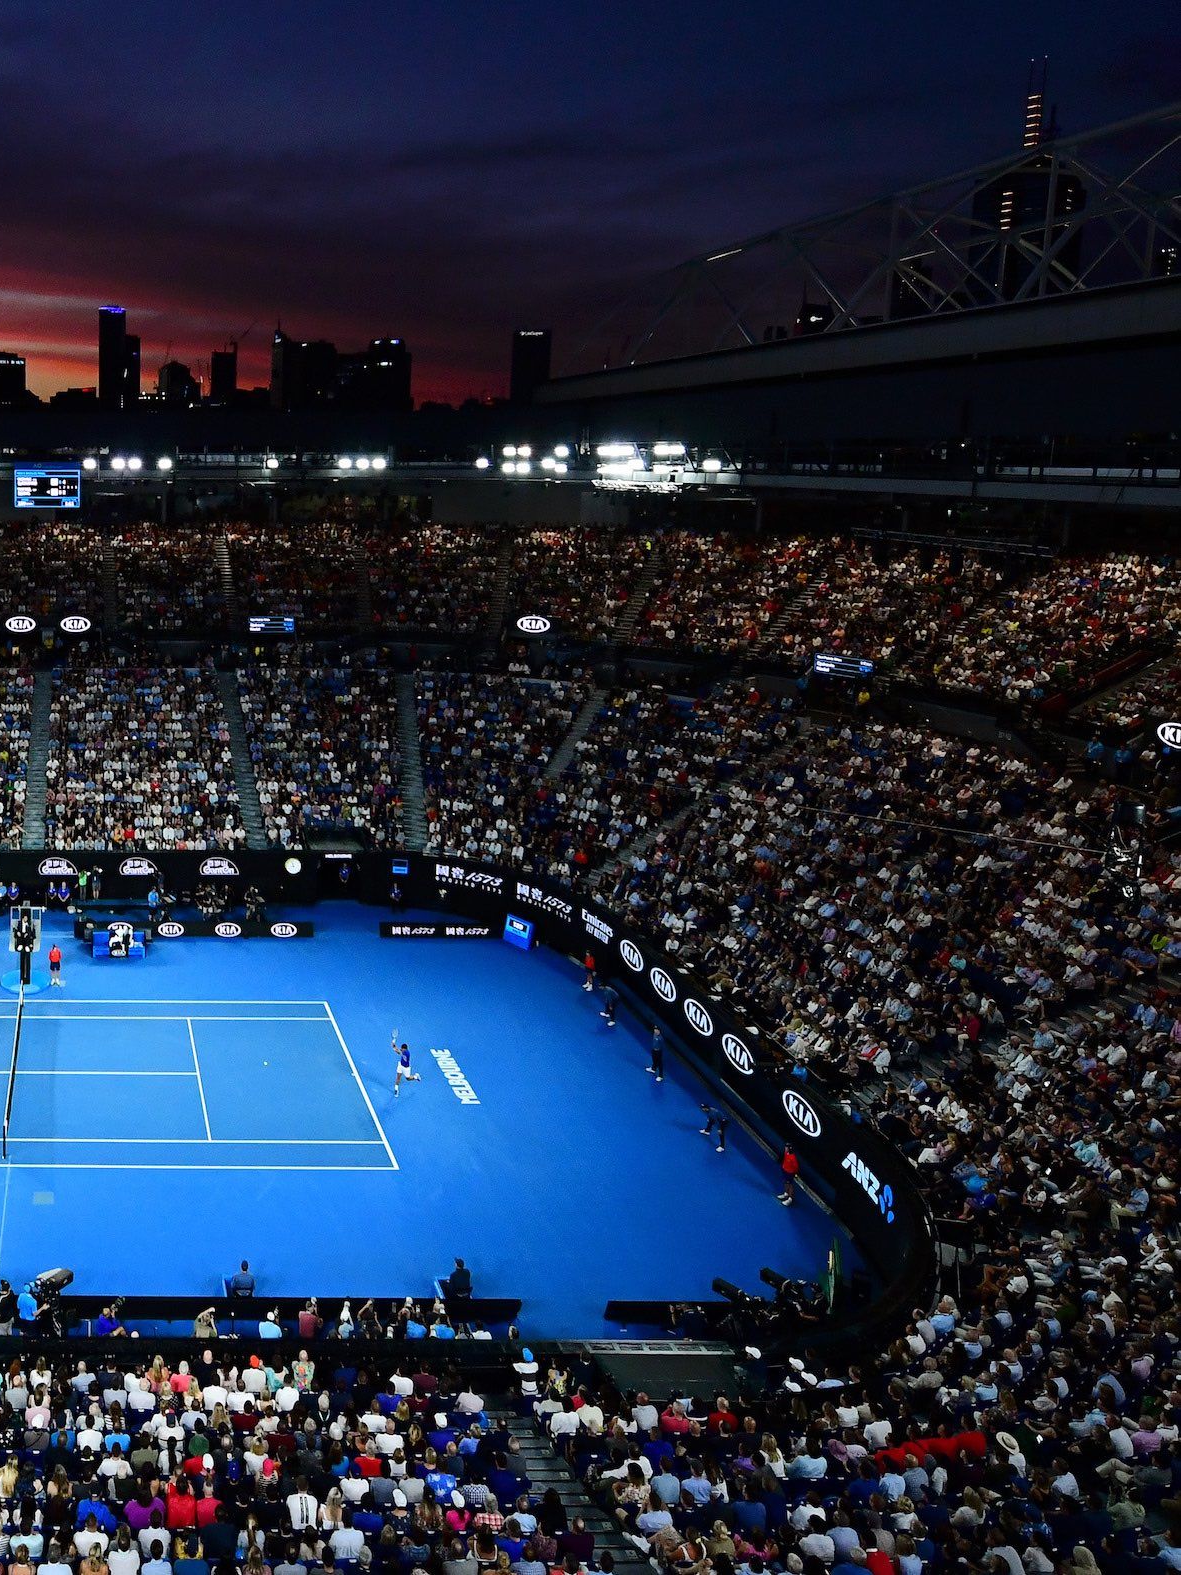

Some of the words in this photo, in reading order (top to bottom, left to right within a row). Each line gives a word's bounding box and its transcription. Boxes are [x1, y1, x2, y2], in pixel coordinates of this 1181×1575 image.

[581, 908, 614, 937] Emirates
[430, 1048, 481, 1105] MELBOURNE
[841, 1151, 880, 1205] ANZ
